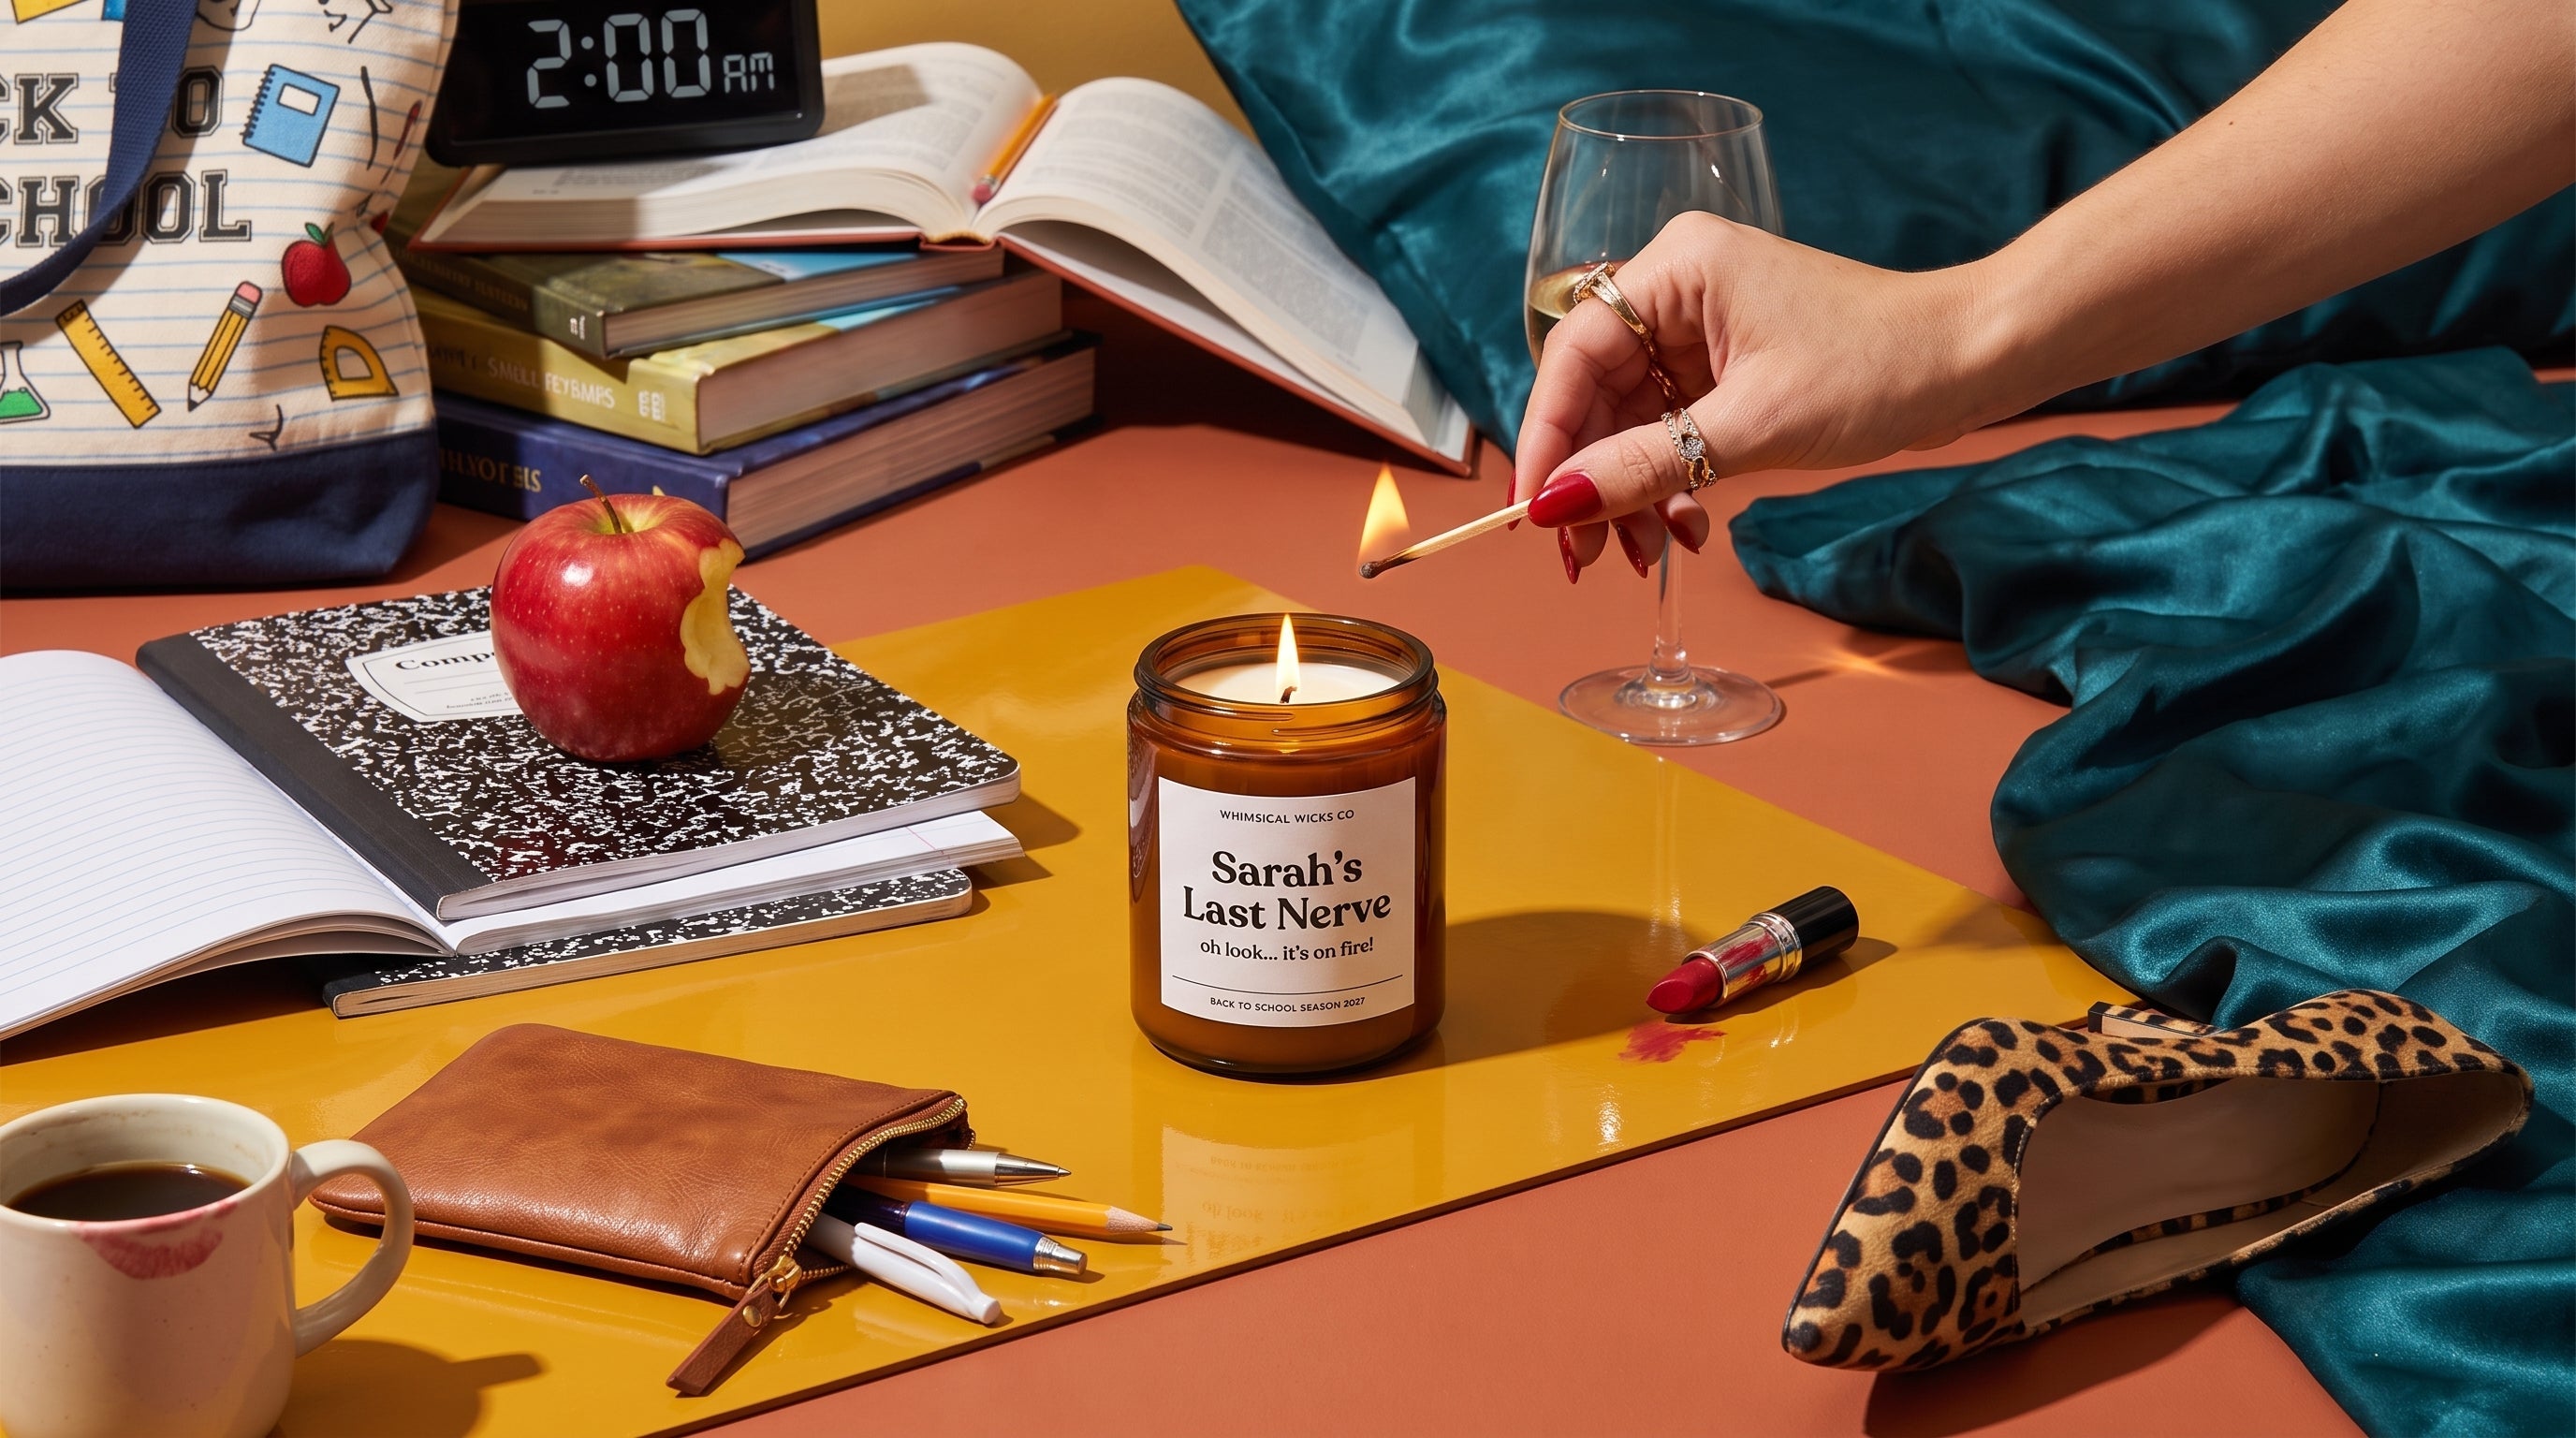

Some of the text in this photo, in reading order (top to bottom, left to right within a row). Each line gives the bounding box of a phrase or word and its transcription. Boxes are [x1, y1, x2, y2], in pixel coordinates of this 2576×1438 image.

[526, 8, 775, 109] 2:00 AM
[0, 66, 224, 146] K O
[0, 169, 252, 250] HOOL
[396, 652, 496, 670] Comp
[1220, 809, 1354, 824] WHIMSICAL WICKS CO
[1211, 850, 1363, 888] Sarah's
[1183, 886, 1392, 930] Last Nerve
[1200, 937, 1373, 961] oh look... it's on fire!
[1210, 996, 1366, 1013] BACK TO SCHOOL SEASON 2027
